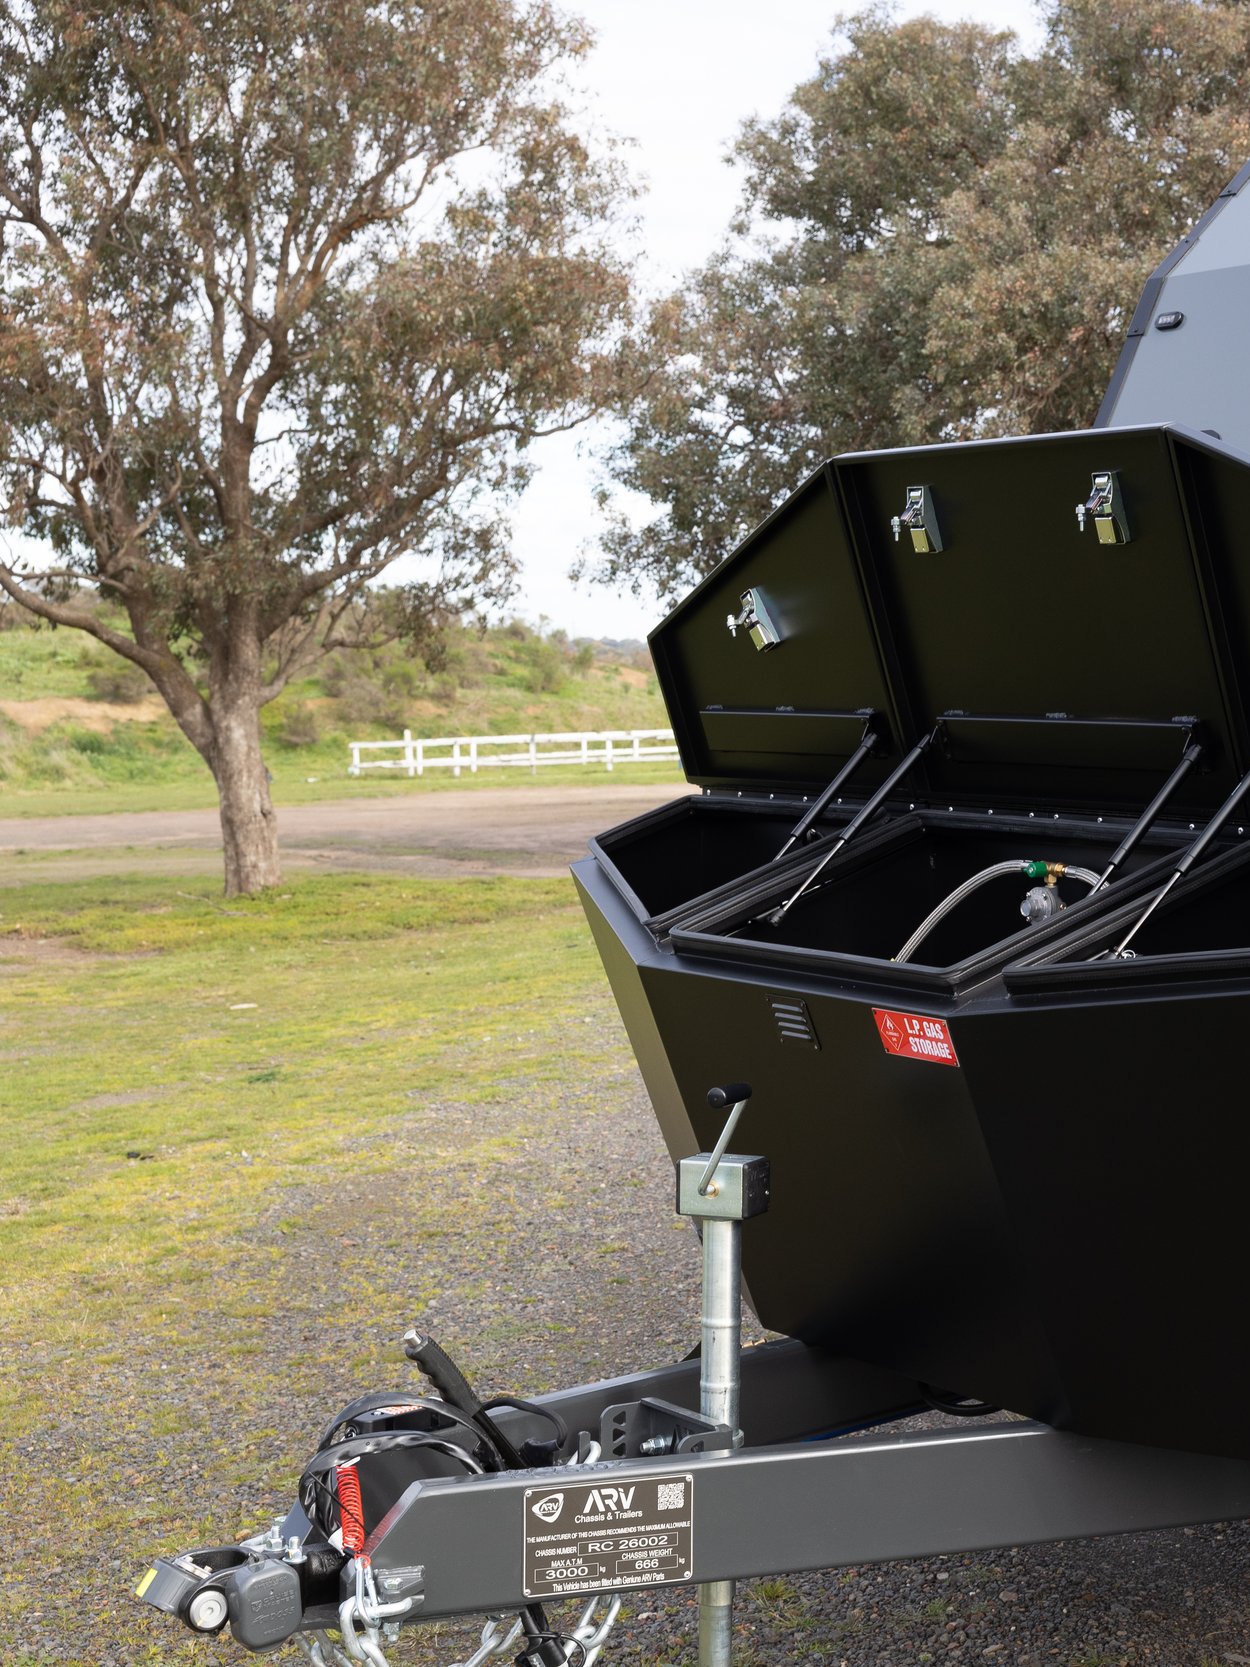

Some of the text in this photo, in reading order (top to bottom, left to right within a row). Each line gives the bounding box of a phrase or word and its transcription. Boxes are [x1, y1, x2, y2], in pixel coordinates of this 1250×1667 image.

[903, 1017, 923, 1036] L.P.
[922, 1021, 944, 1040] GAS
[908, 1036, 952, 1059] STORAGE
[540, 1502, 559, 1512] ARV
[583, 1486, 635, 1513] ARV
[574, 1510, 643, 1524] Chassis & Trailers
[536, 1533, 571, 1543] MANUFACTURER
[588, 1529, 607, 1537] CHASSIS
[607, 1526, 637, 1536] RECOMMENDS
[646, 1523, 666, 1531] MAXIMUM
[665, 1521, 691, 1529] ALLOWABLE
[535, 1535, 668, 1557] CHASSIS NUMBER RC 26002
[621, 1548, 673, 1560] CHASSIS WEIGHT
[551, 1560, 565, 1568] MAX
[635, 1557, 685, 1570] 666 kg
[545, 1566, 588, 1580] 3000
[552, 1583, 563, 1592] This
[563, 1581, 580, 1591] Vehicle
[580, 1580, 589, 1588] has
[589, 1579, 601, 1588] been
[601, 1577, 613, 1587] fitted
[613, 1576, 622, 1585] with
[641, 1573, 653, 1582] ARV
[652, 1572, 665, 1581] Parts
